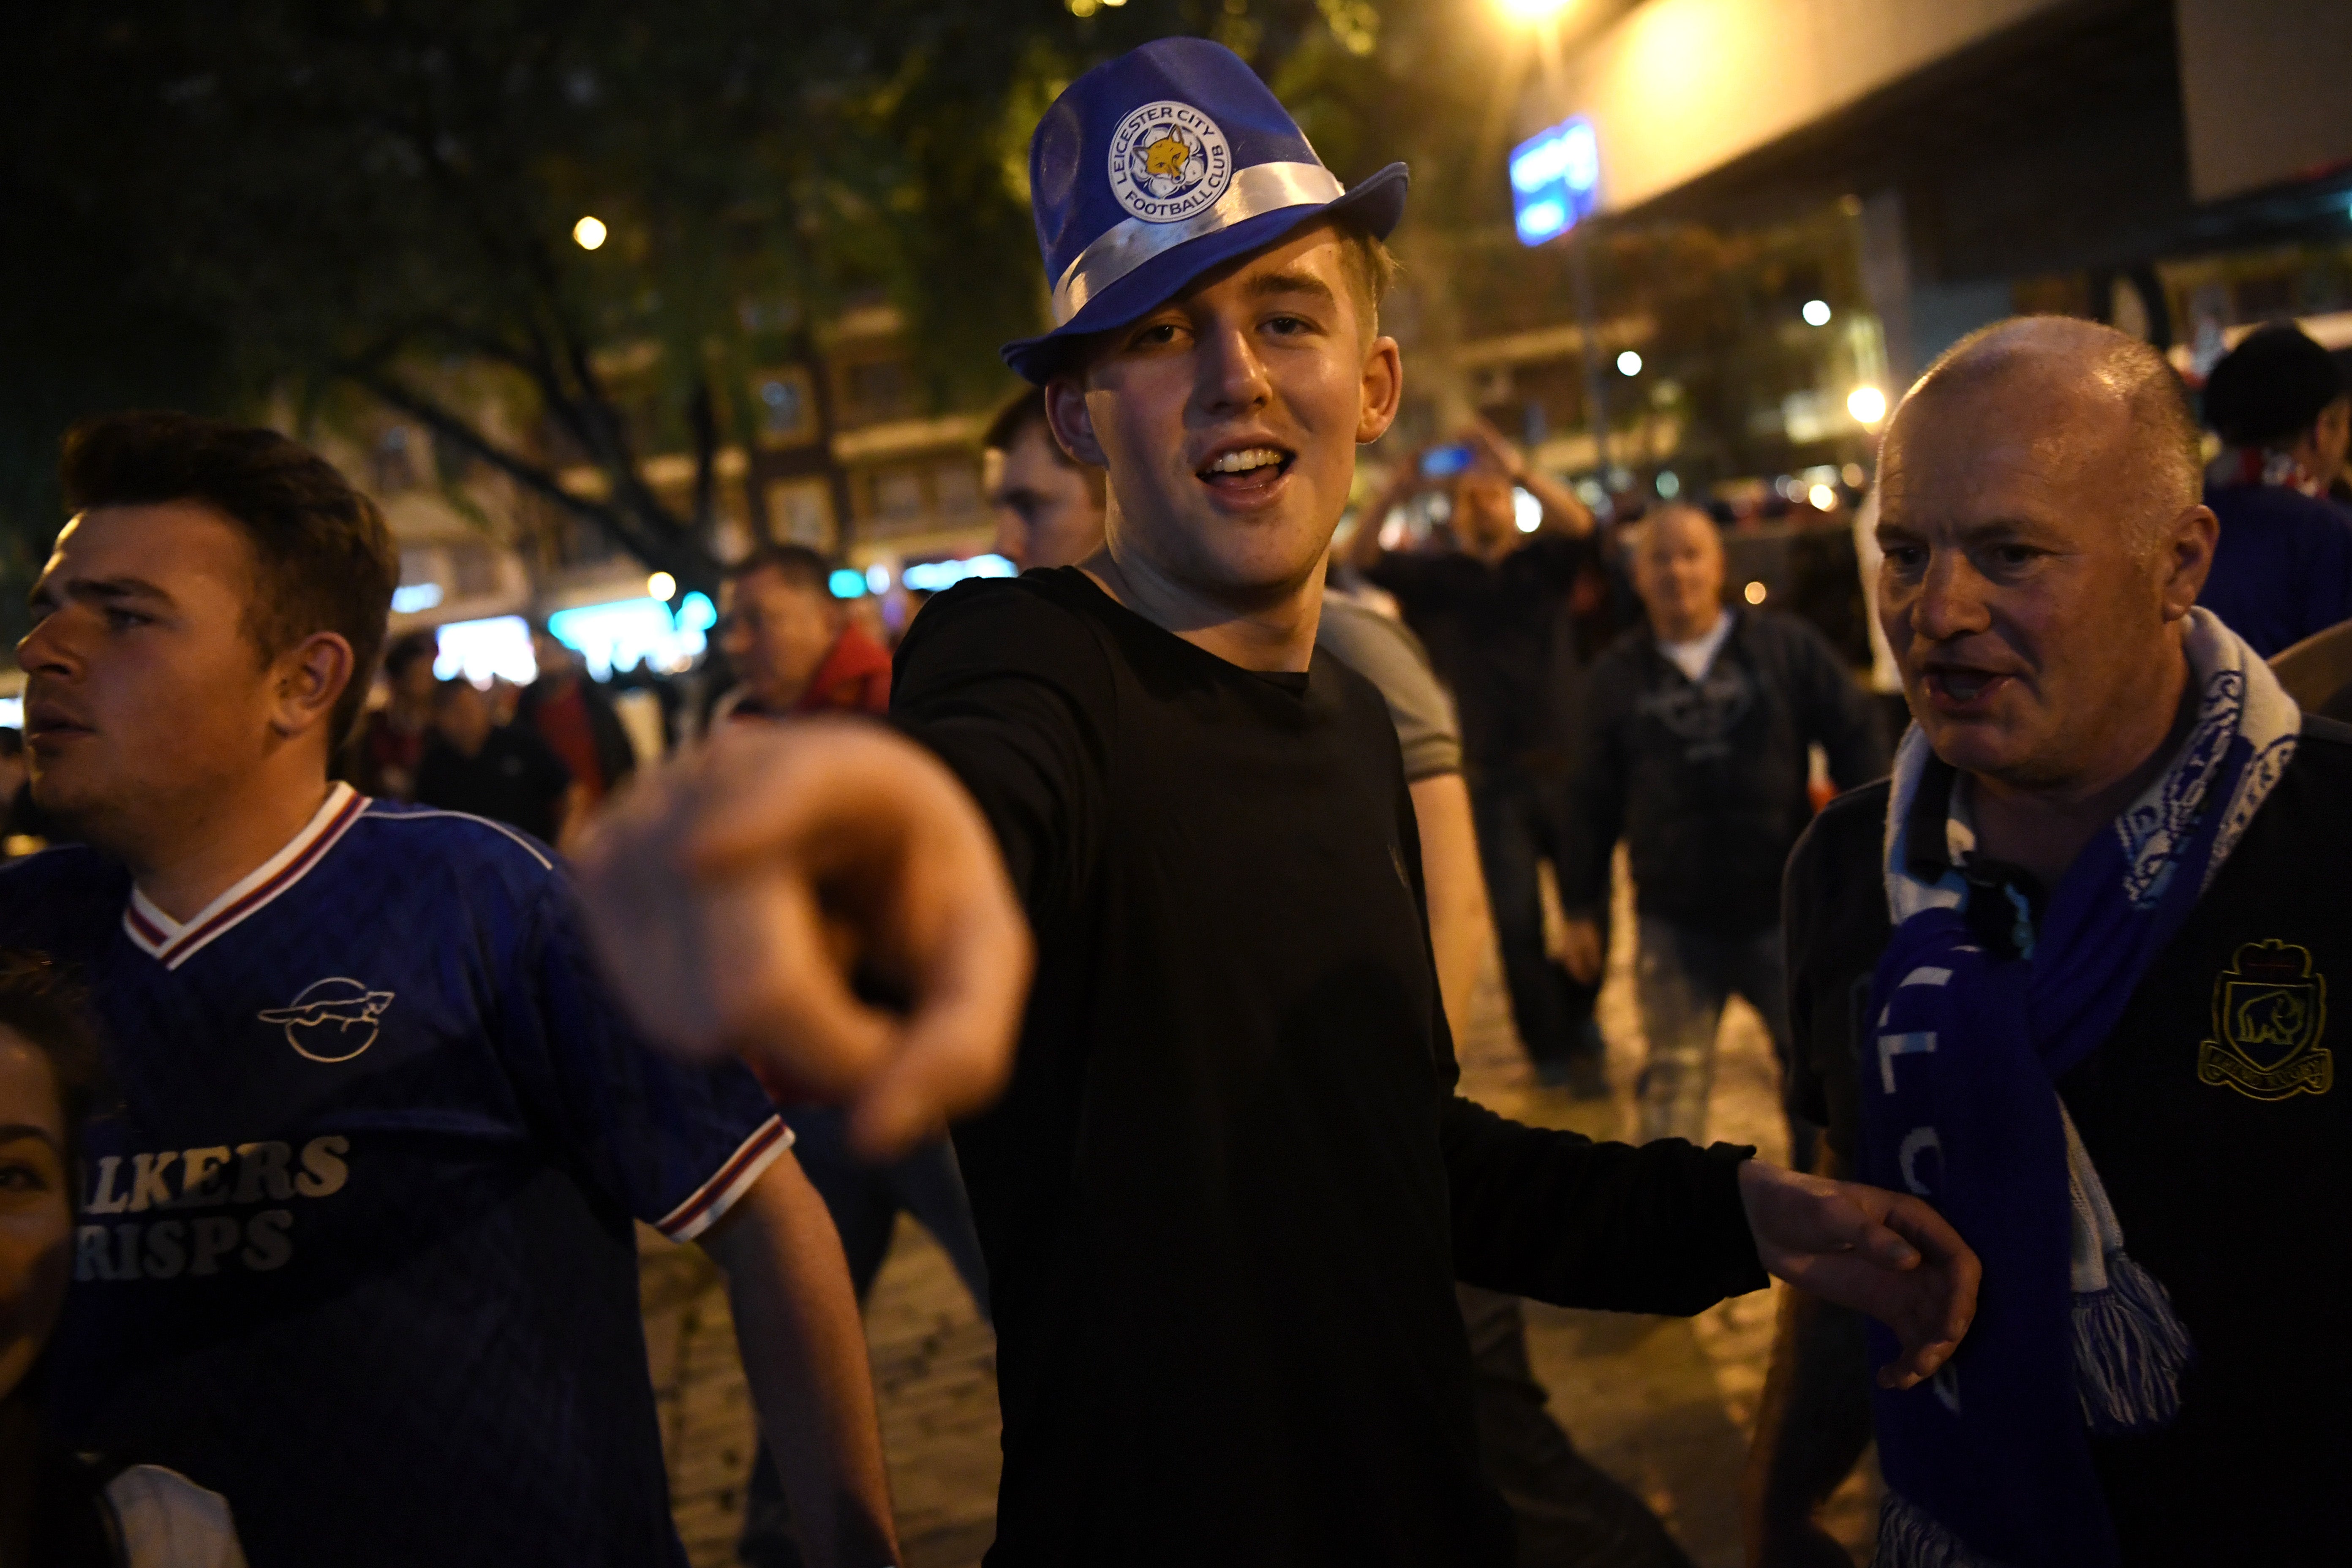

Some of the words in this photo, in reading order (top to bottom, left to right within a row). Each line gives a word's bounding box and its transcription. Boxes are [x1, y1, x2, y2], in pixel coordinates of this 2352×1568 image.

[1113, 107, 1173, 185] LEICESTER
[1177, 110, 1214, 136] CITY
[1125, 190, 1213, 216] FOOTBALL
[1208, 144, 1225, 188] CLUB
[77, 1135, 351, 1215] LKERS
